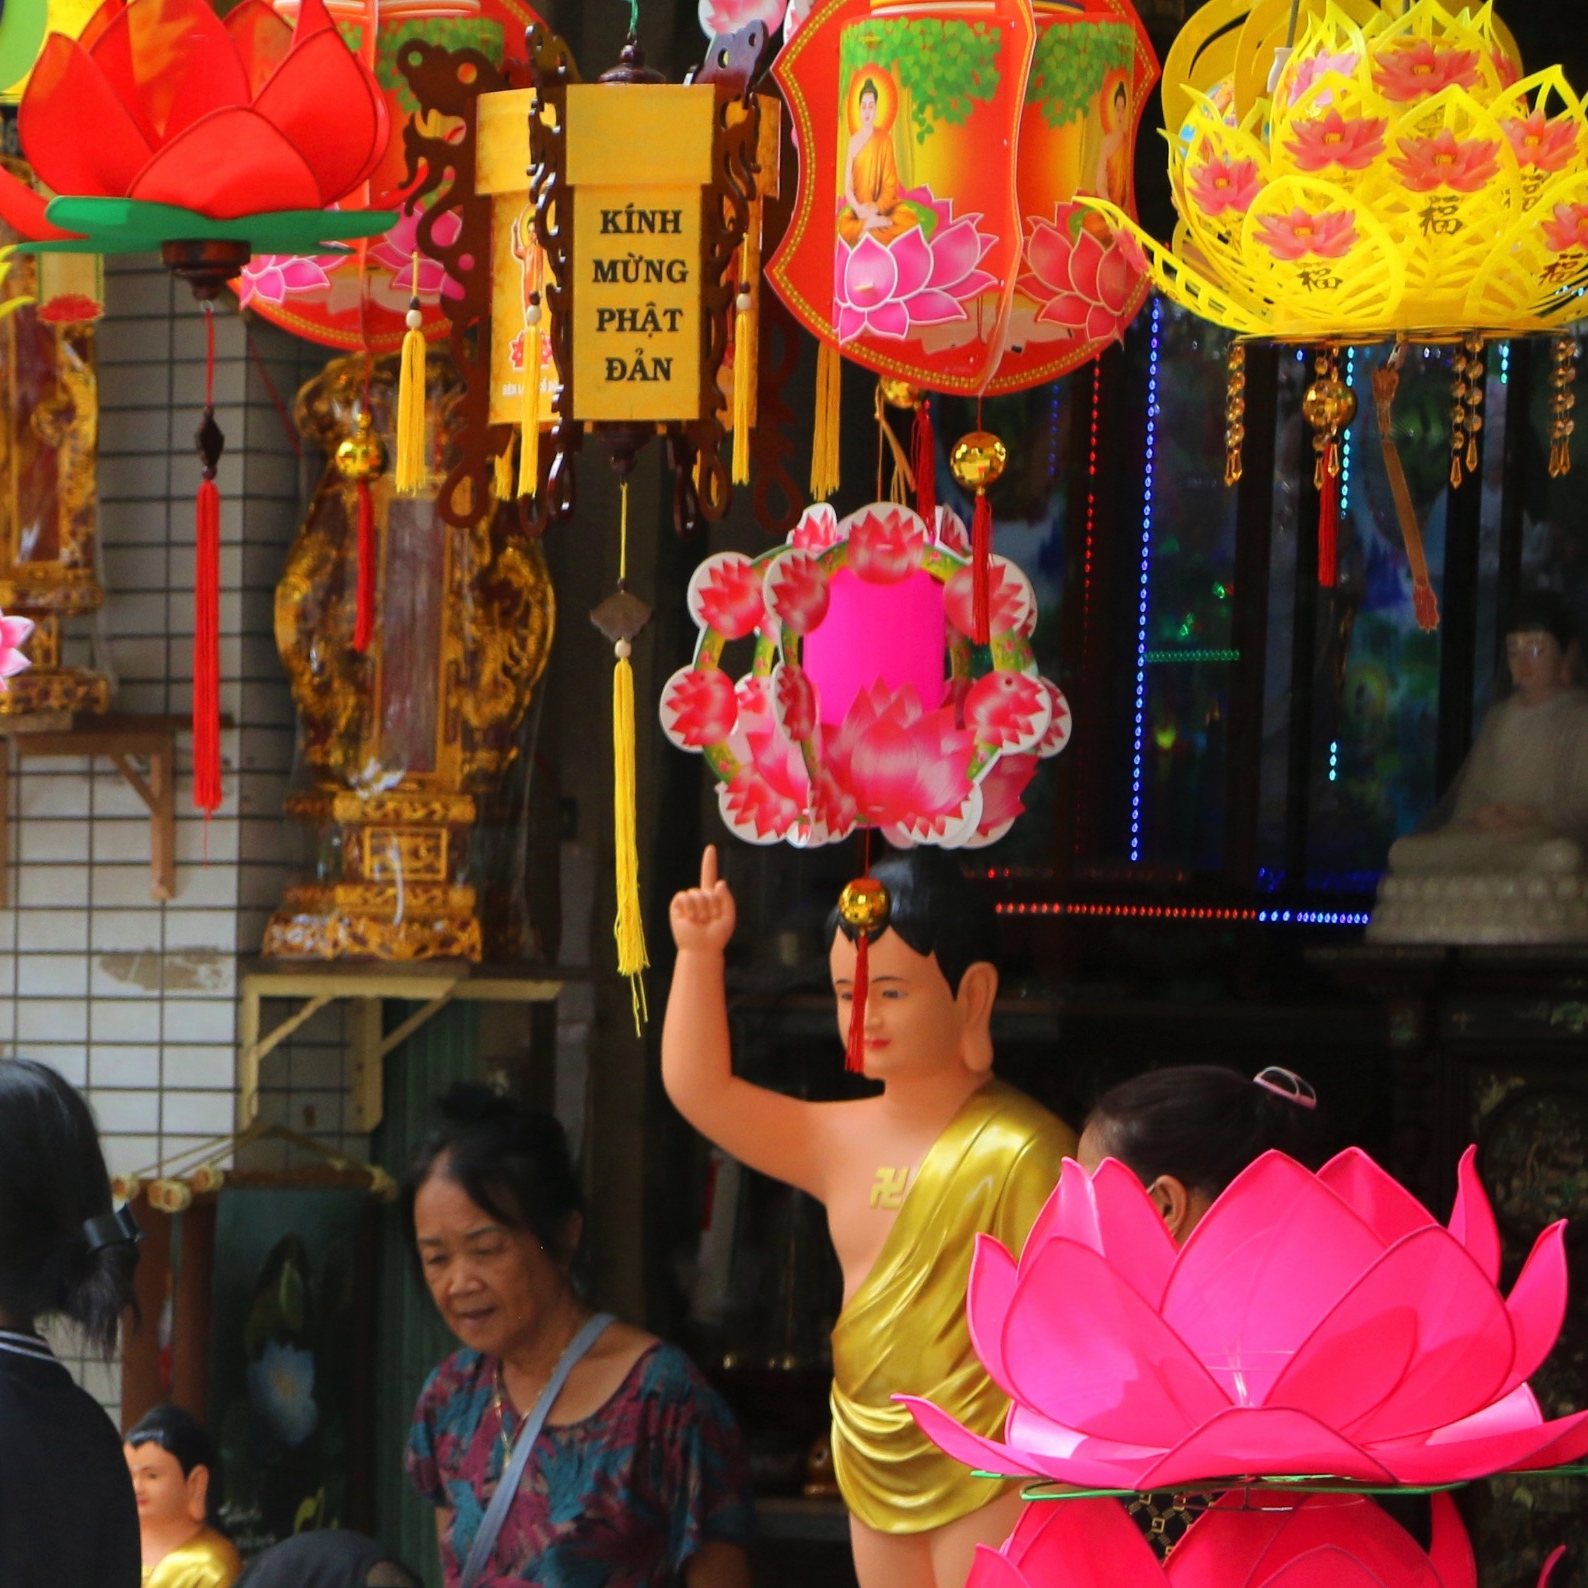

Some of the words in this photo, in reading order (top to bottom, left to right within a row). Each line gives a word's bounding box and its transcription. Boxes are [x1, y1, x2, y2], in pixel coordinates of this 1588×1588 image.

[600, 202, 682, 234] KÍNH
[1417, 194, 1464, 237] 福
[592, 252, 689, 283] MỪNG
[1296, 261, 1344, 293] 福
[596, 301, 684, 338] PHẬT
[605, 347, 673, 382] ĐẢN
